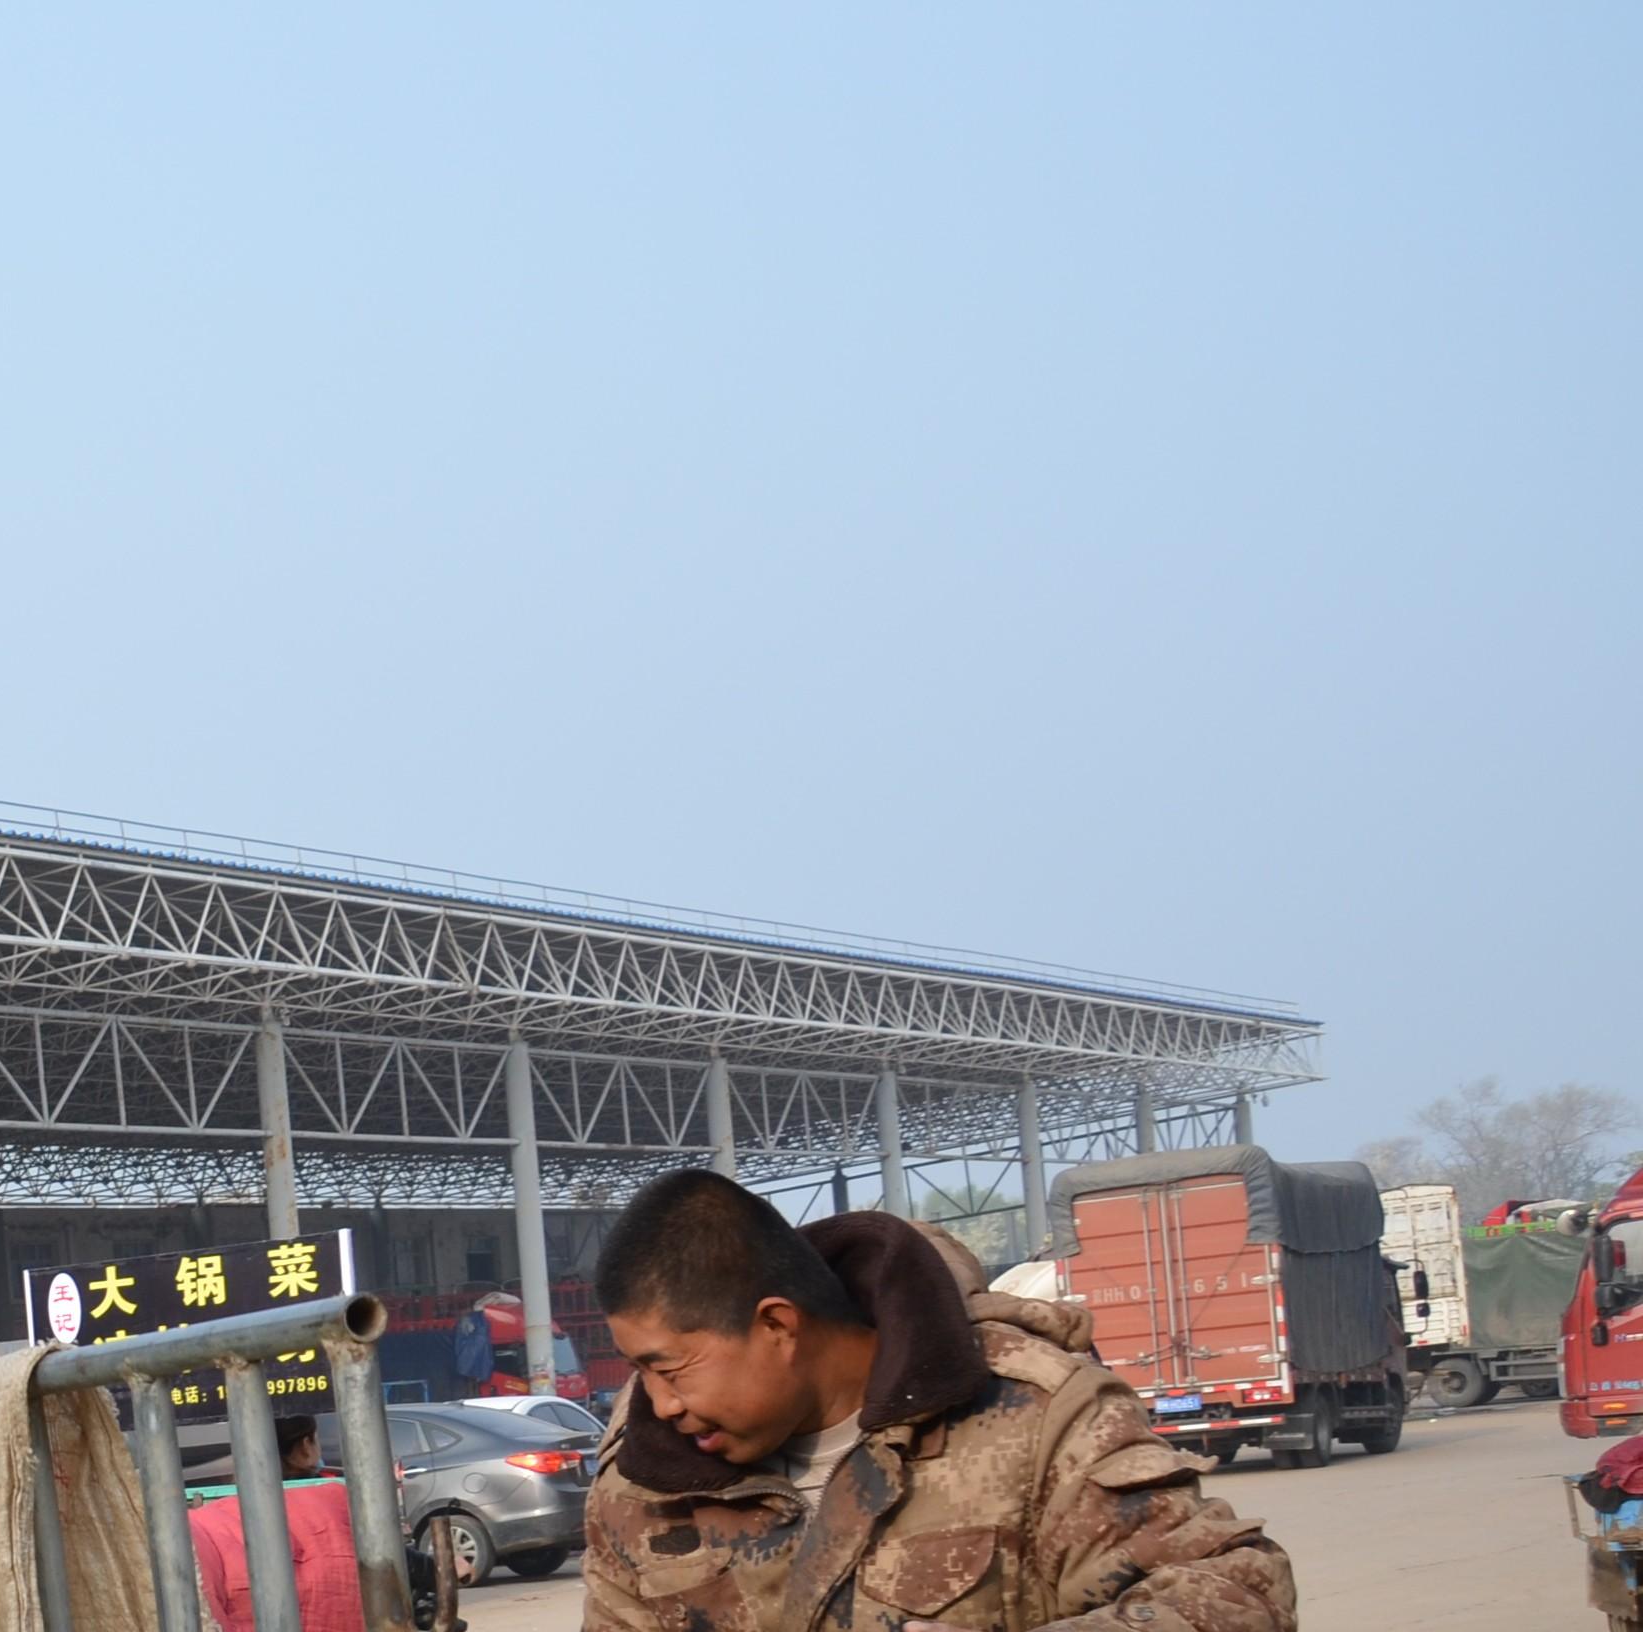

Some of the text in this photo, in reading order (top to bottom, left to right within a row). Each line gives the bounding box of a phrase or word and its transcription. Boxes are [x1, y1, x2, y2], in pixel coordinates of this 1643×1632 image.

[52, 1284, 76, 1334] 王记
[88, 1243, 319, 1319] 大锅菜
